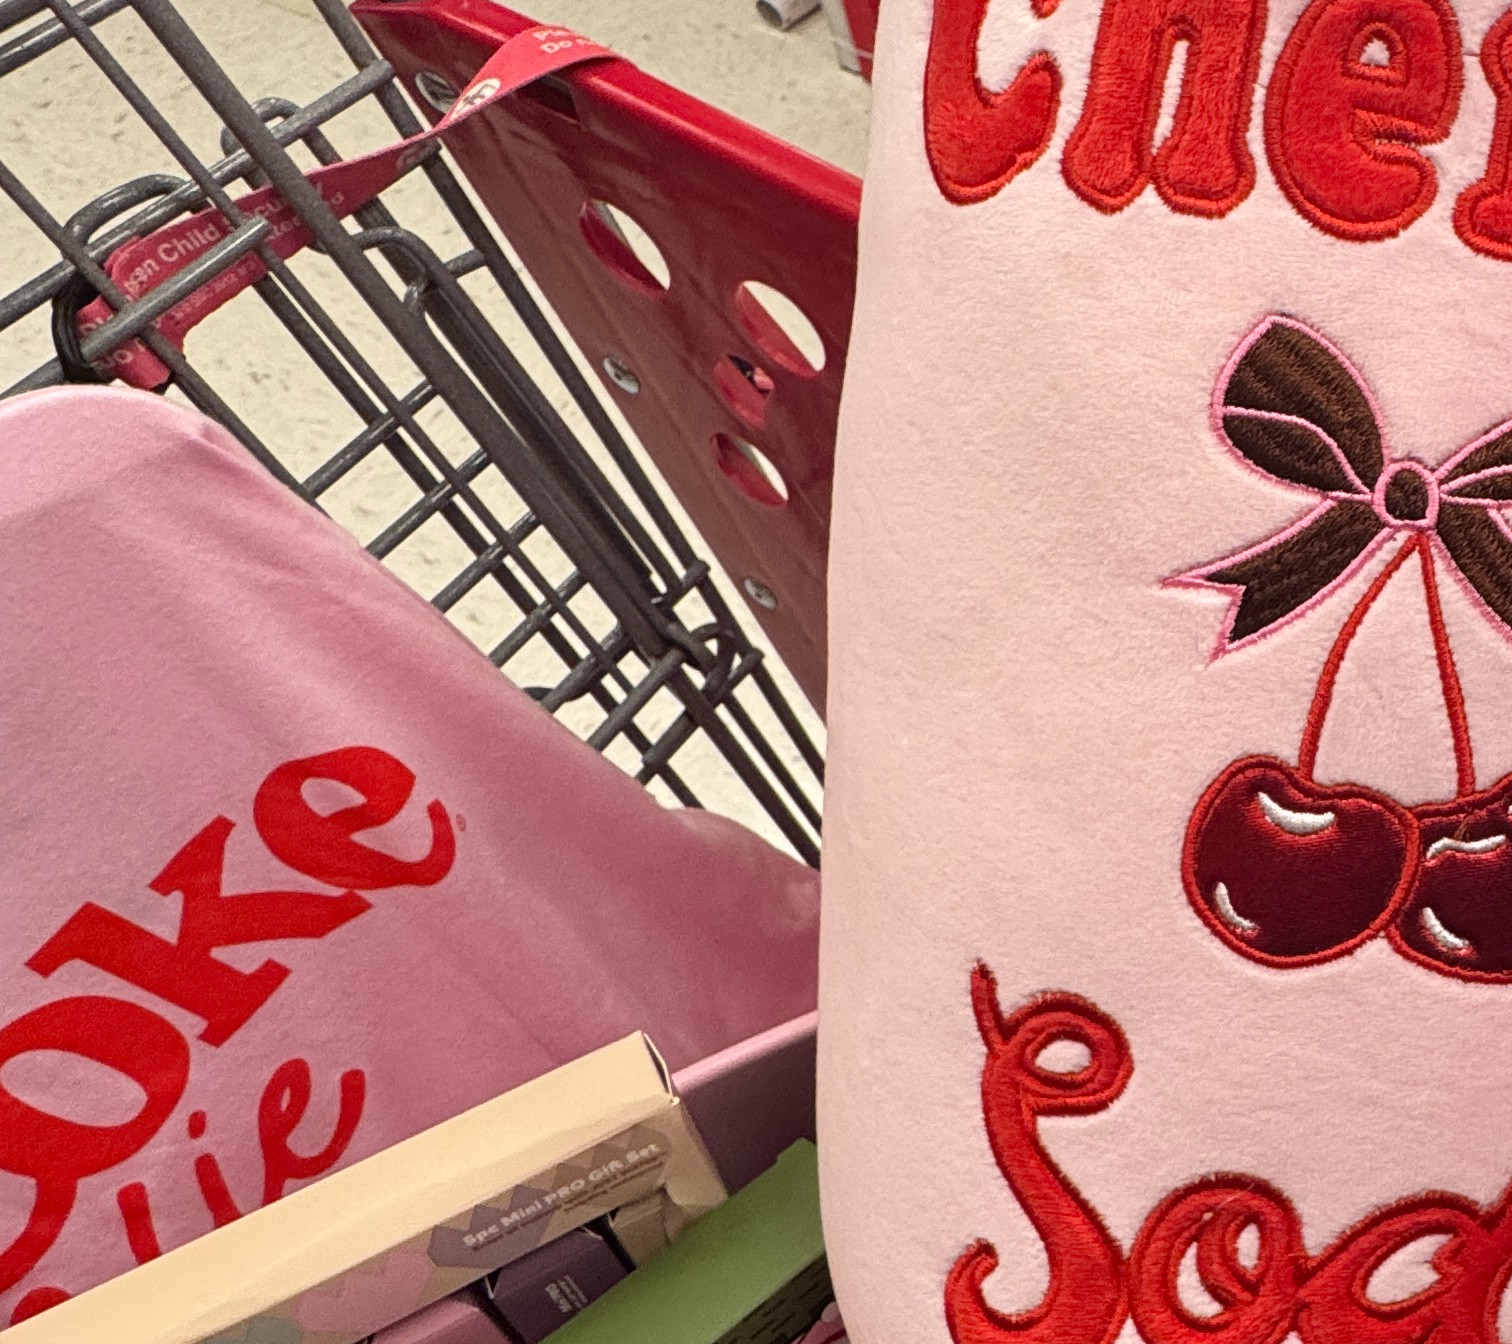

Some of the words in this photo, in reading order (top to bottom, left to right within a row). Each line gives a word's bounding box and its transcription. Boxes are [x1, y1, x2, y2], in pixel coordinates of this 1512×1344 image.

[158, 222, 221, 264] Child
[500, 1199, 543, 1227] Mini
[544, 1177, 586, 1203] PRO
[588, 1159, 625, 1182] Gift
[626, 1143, 660, 1163] Set
